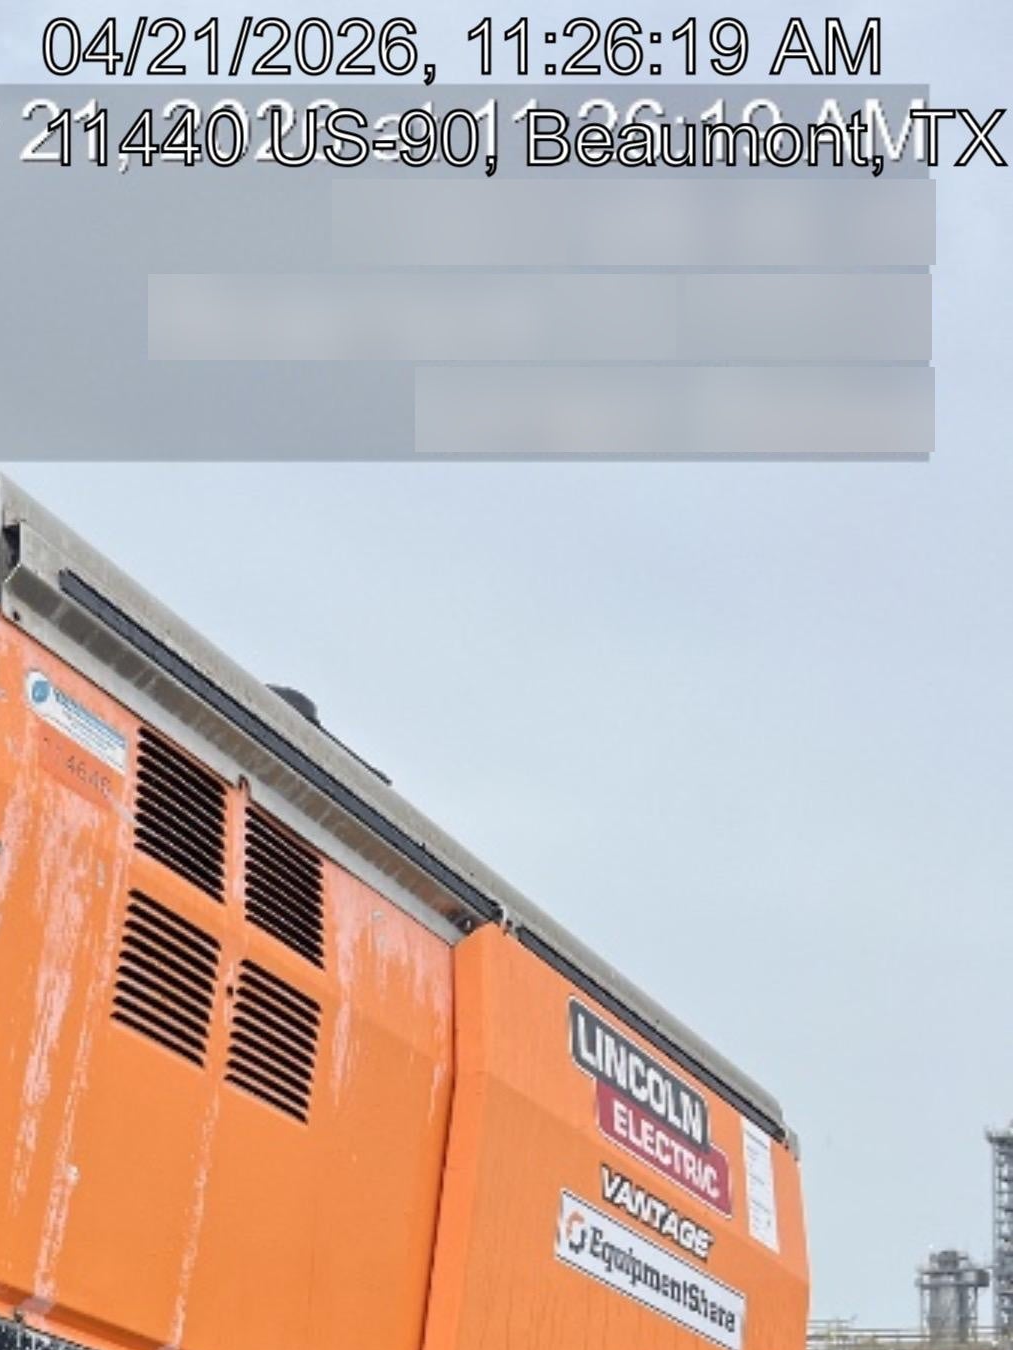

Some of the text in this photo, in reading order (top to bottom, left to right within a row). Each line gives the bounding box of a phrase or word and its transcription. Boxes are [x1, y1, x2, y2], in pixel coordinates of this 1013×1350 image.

[576, 1012, 705, 1146] LINCOLN
[612, 1100, 721, 1200] ELECTRIC
[600, 1164, 715, 1261] VANTAGE
[588, 1225, 736, 1334] EquipmentShare
